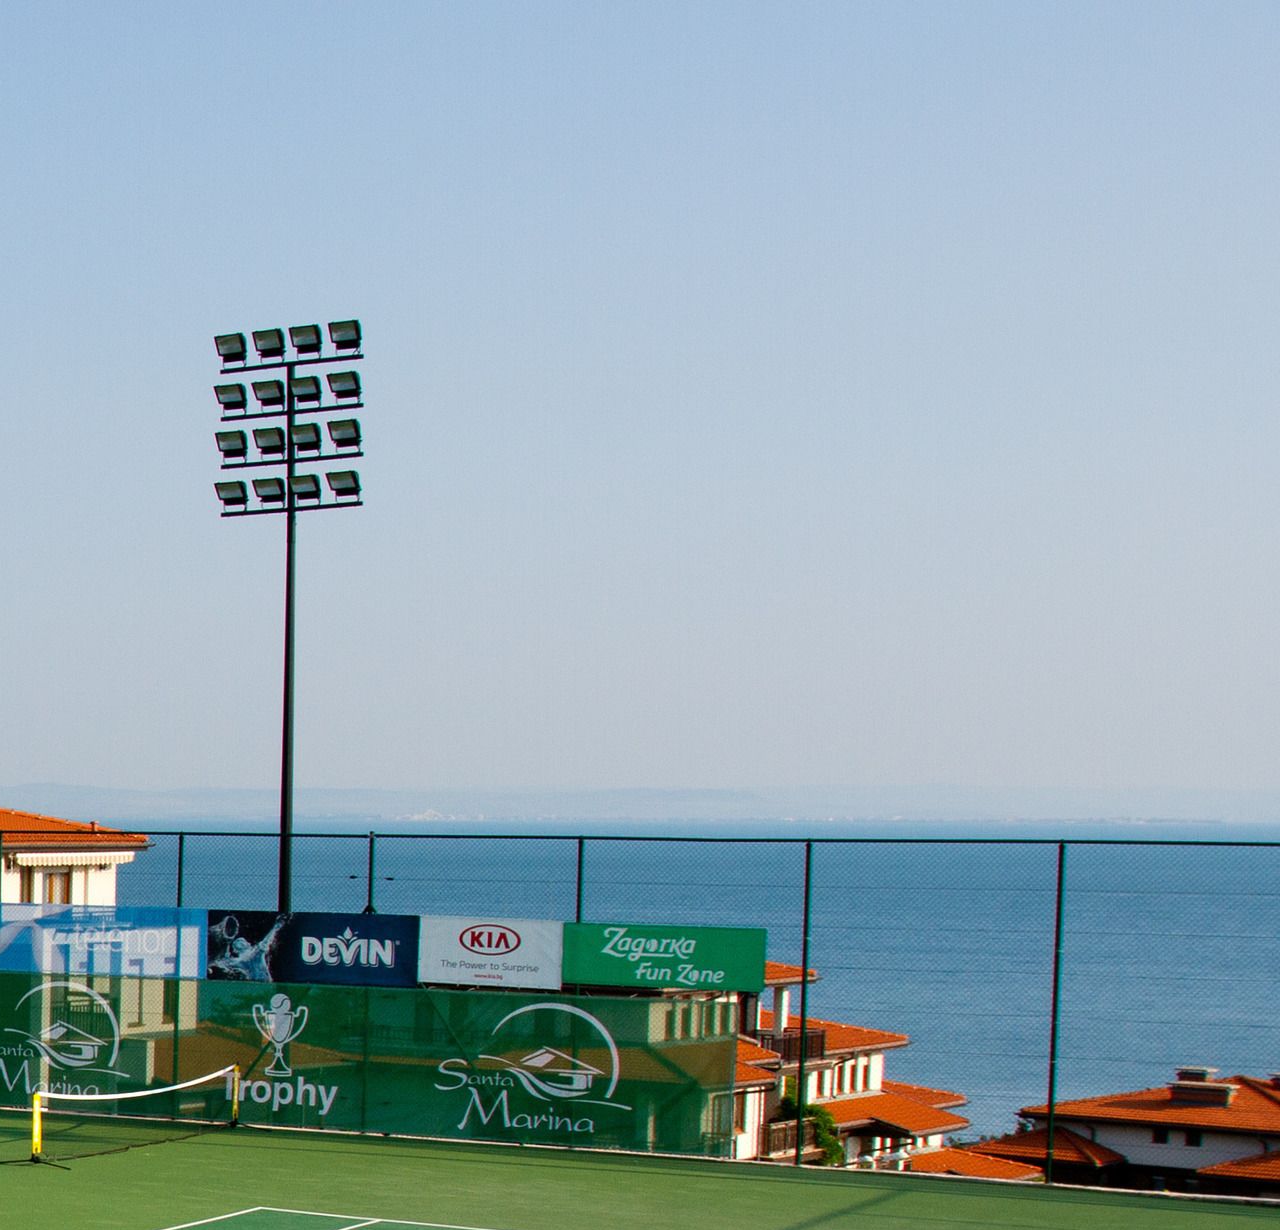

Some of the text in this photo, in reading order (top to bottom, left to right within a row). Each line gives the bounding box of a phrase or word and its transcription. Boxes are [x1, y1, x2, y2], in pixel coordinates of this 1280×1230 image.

[74, 922, 176, 953] telenor
[301, 935, 395, 968] DEVIN
[470, 931, 510, 949] KIA
[601, 927, 697, 961] Zagorka
[440, 959, 539, 974] The Power to Surprise
[635, 962, 725, 986] Fun Zone
[434, 1058, 515, 1091] Santa
[223, 1072, 338, 1116] Trophy
[457, 1087, 595, 1133] Marina
